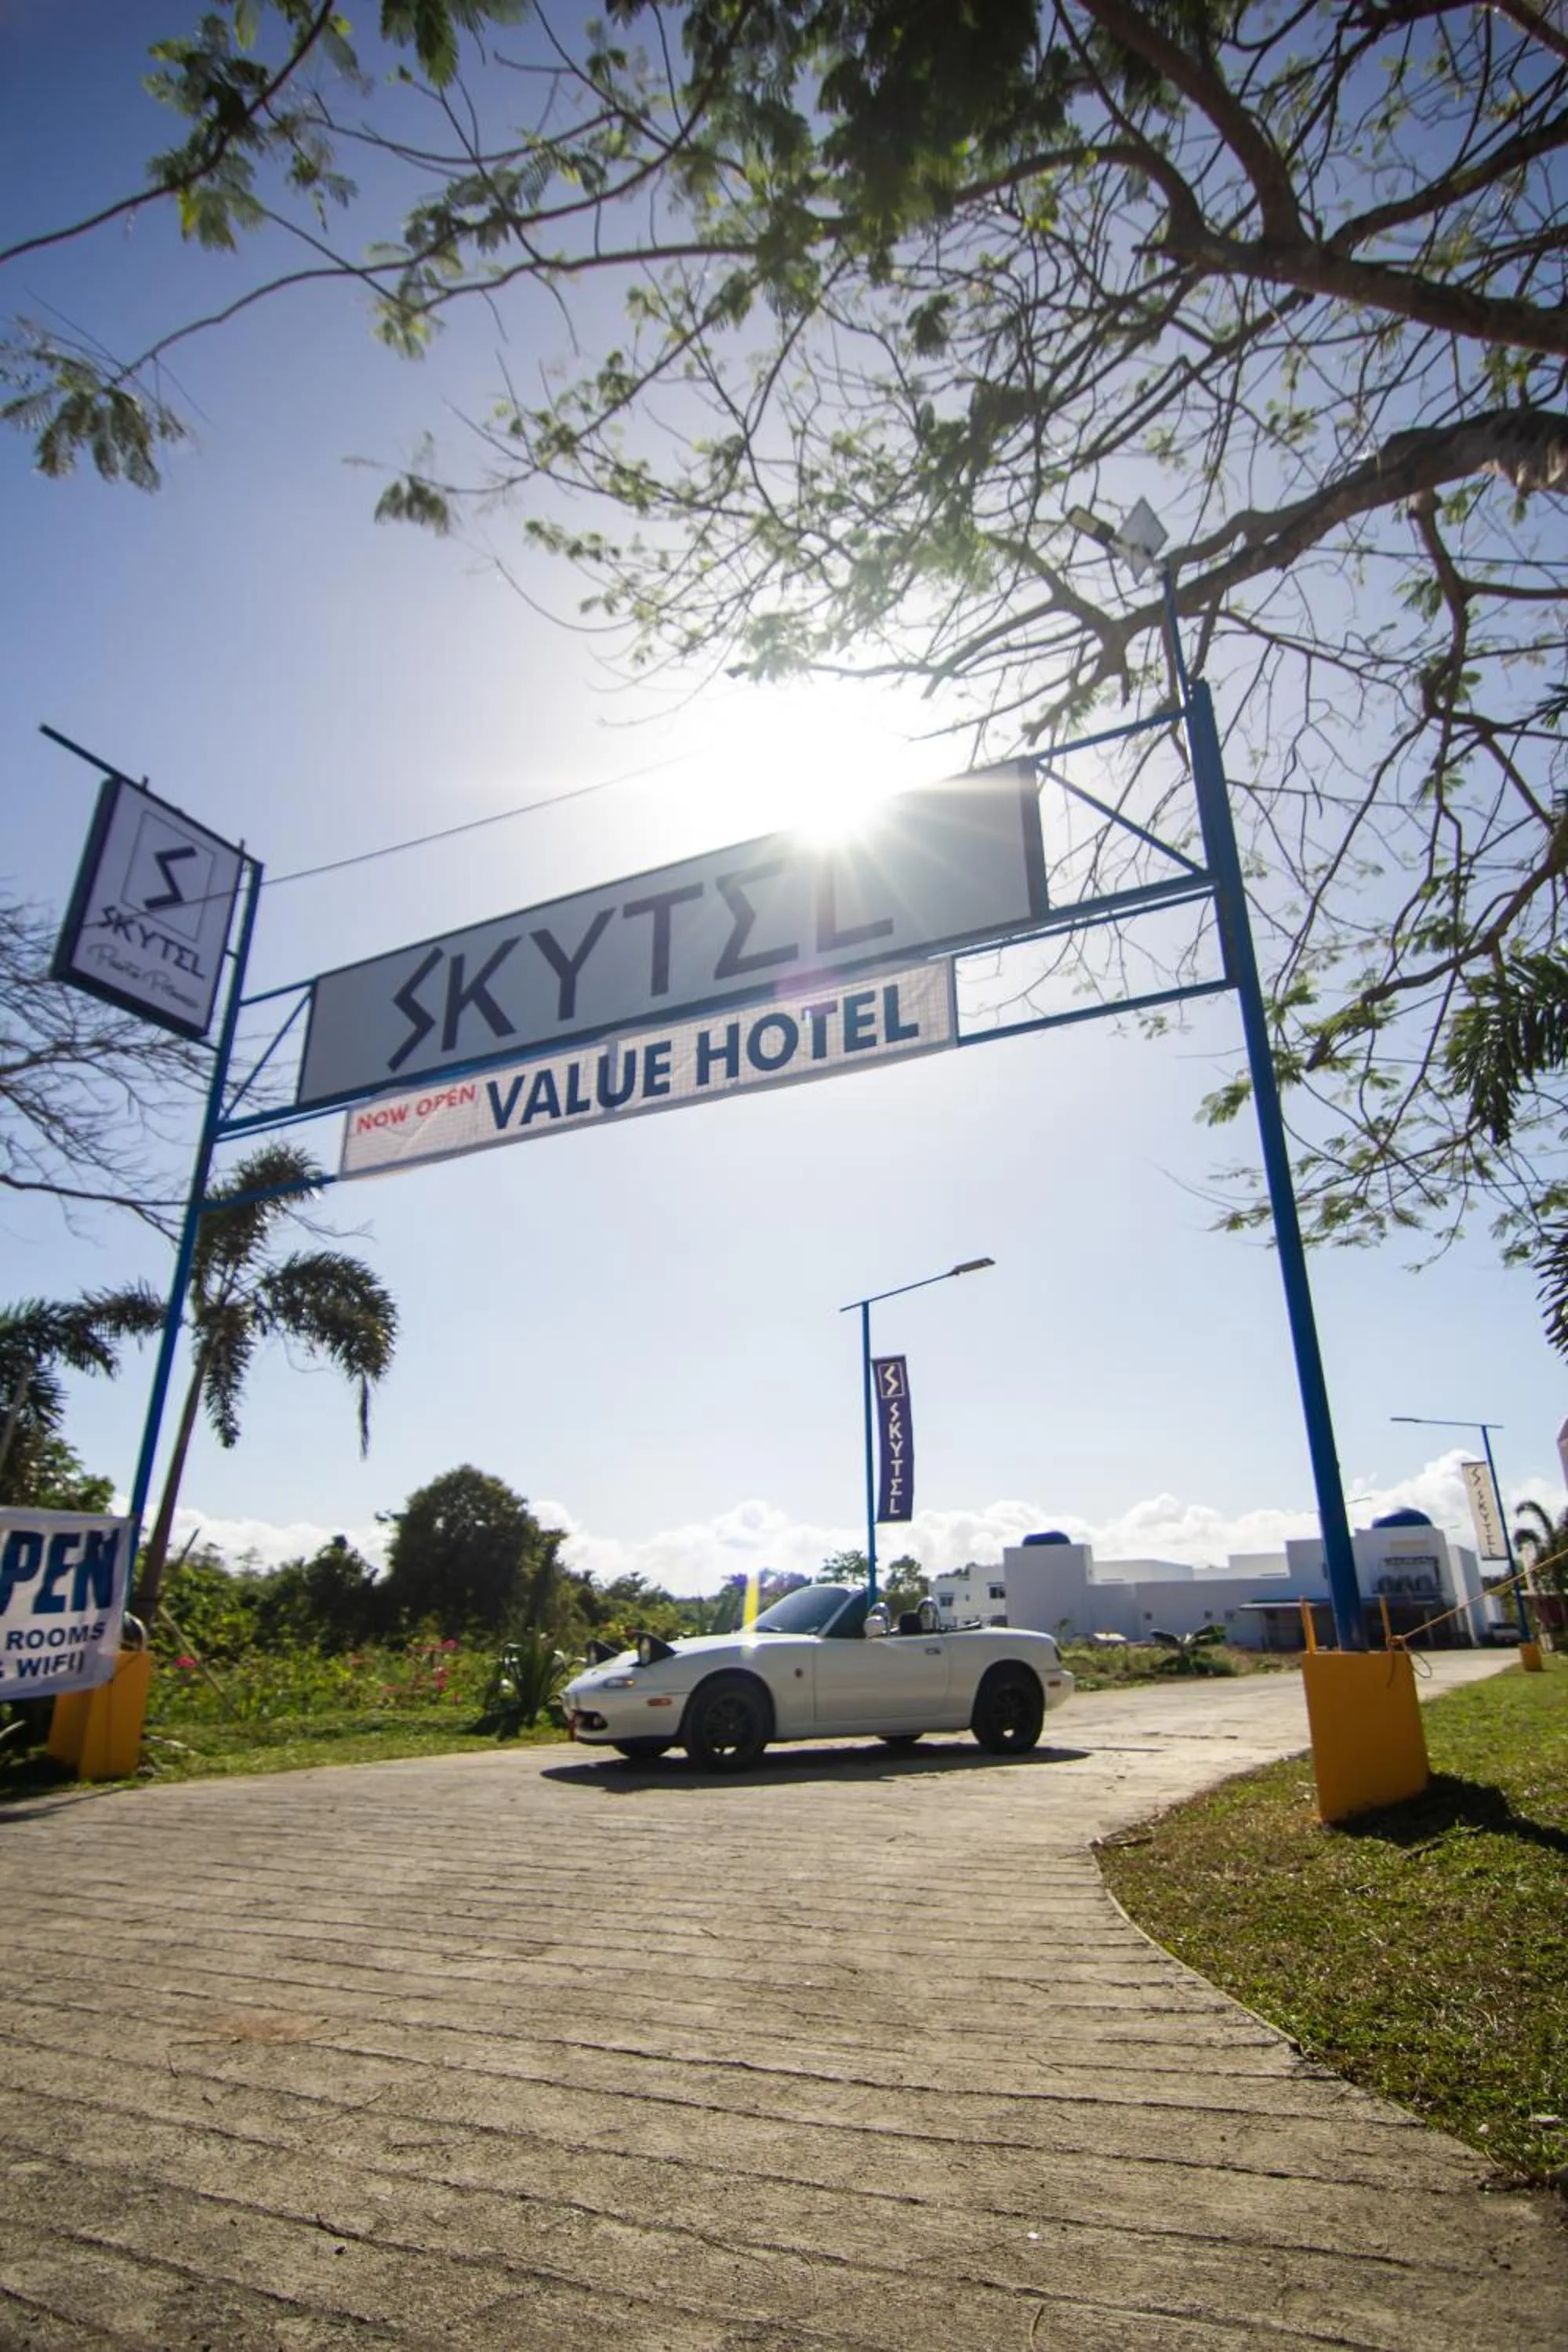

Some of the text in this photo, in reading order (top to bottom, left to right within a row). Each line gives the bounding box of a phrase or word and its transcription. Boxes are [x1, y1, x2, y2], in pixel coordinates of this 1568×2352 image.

[355, 983, 920, 1134] NOW OPEN VALUE HOTEL
[5, 1621, 107, 1651] ROOMS
